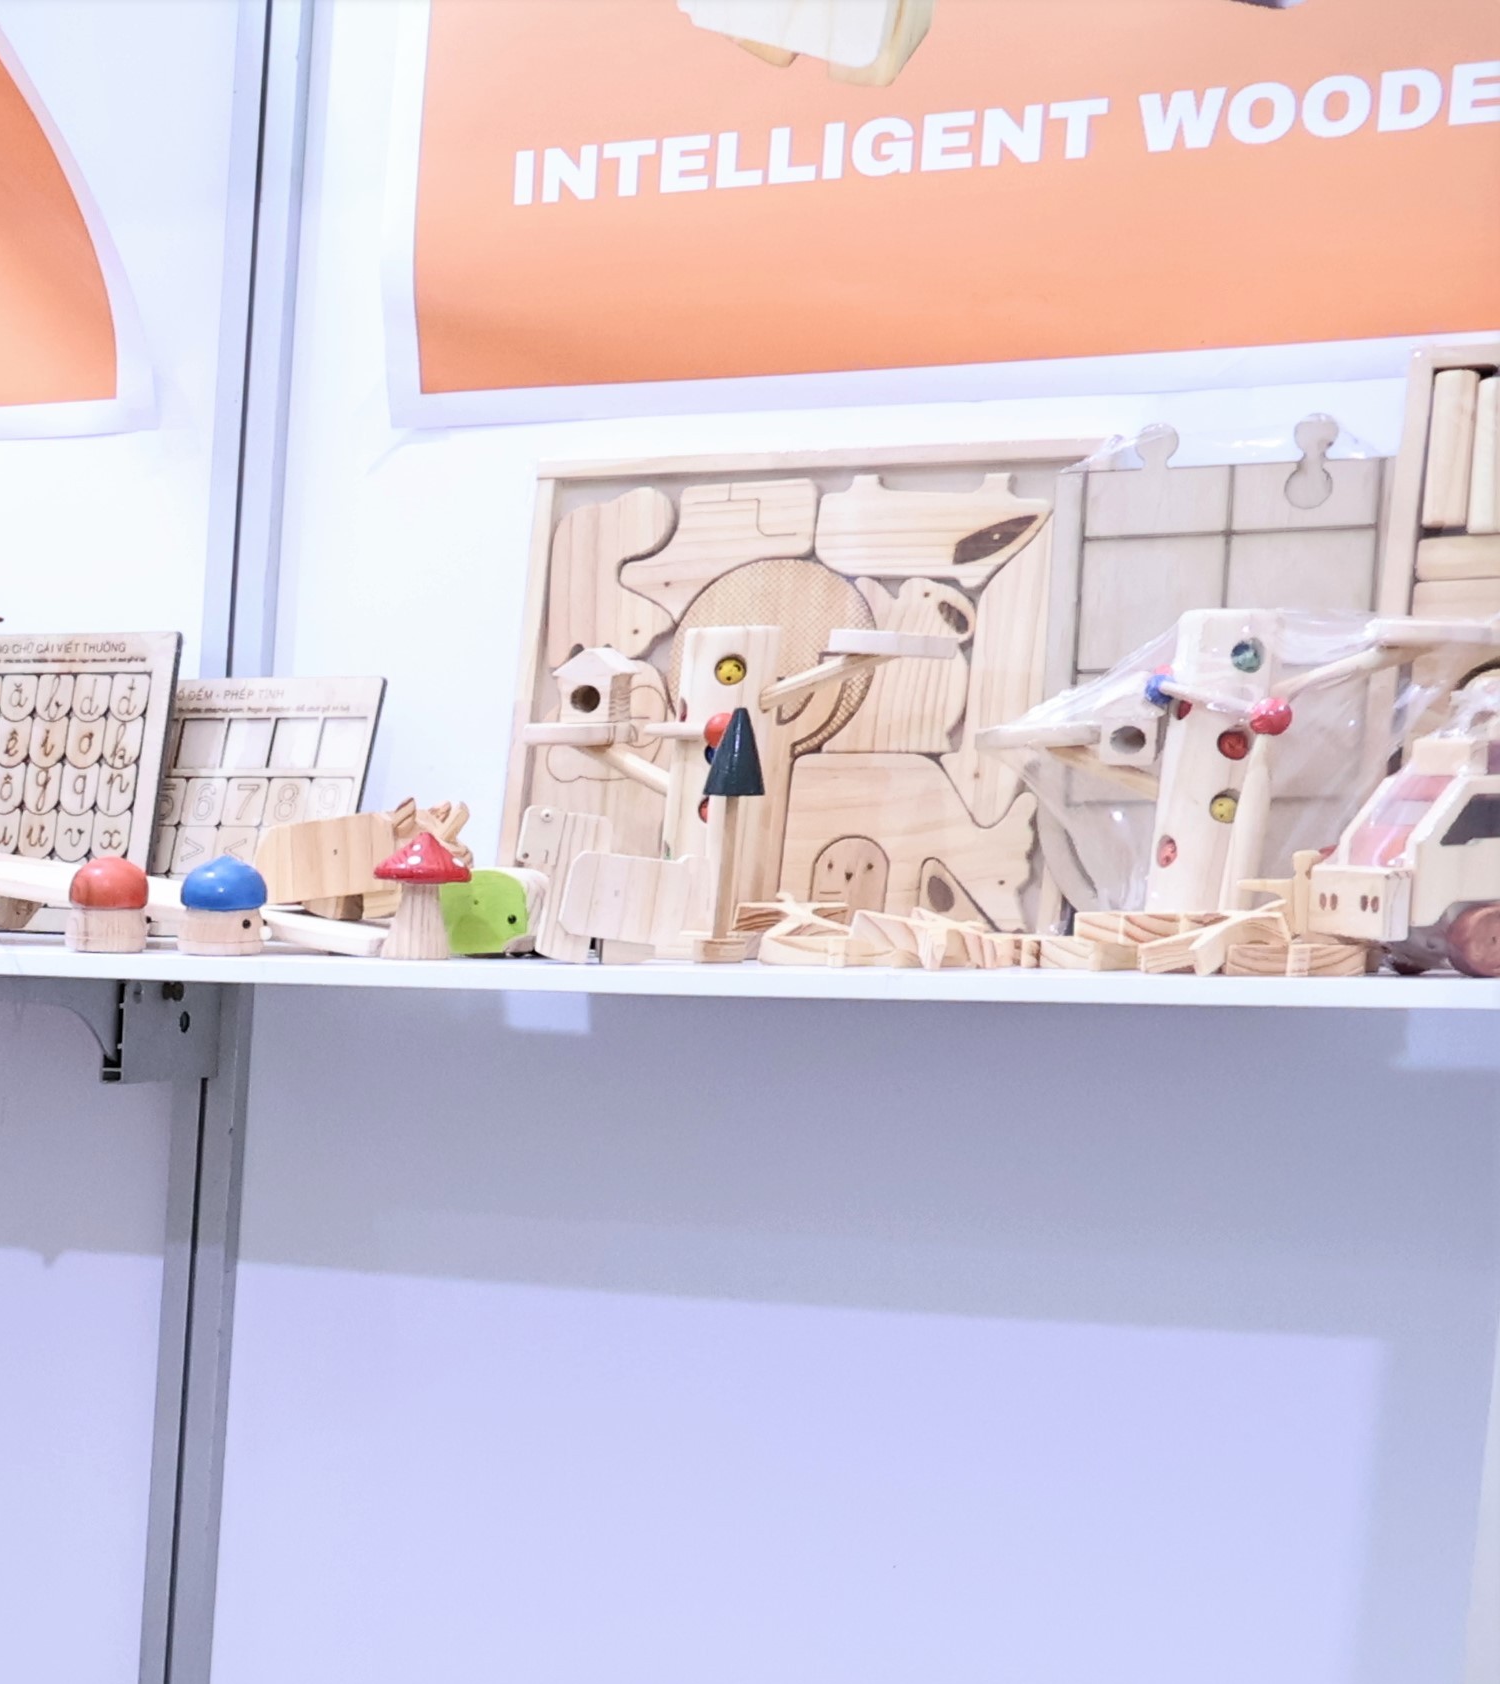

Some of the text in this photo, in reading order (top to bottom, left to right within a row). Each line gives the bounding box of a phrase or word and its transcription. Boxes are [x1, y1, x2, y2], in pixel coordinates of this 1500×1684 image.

[513, 97, 1109, 206] INTELLIGENT
[236, 783, 261, 821] 7
[274, 782, 300, 821] 8
